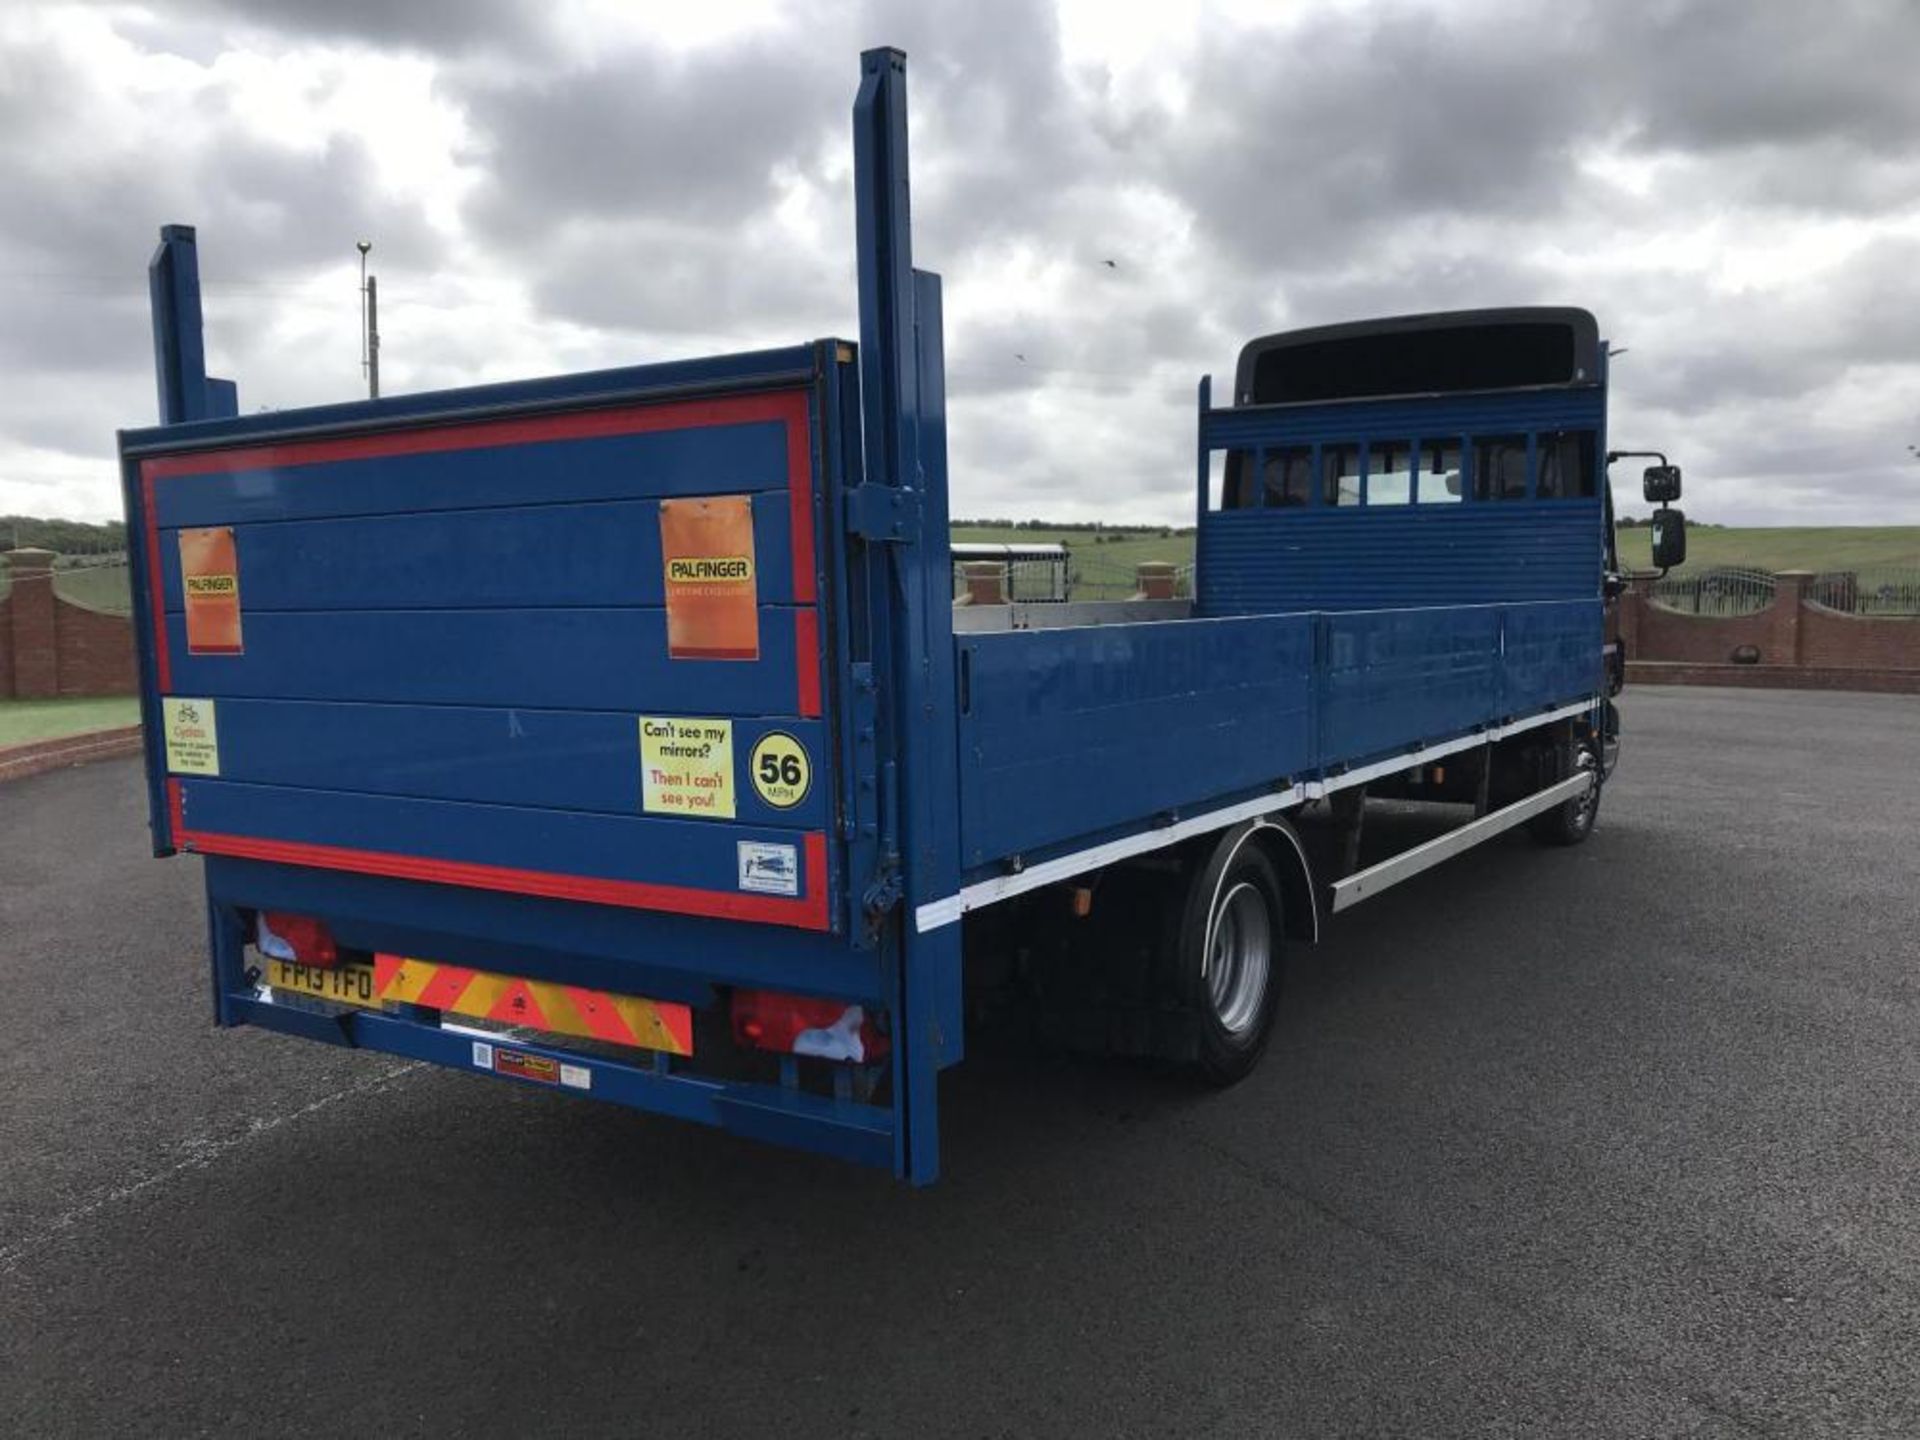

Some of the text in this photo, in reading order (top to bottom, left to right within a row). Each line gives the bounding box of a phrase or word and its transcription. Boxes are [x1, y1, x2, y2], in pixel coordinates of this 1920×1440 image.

[671, 561, 748, 579] PALFINGER
[187, 577, 233, 591] PALFINGER
[644, 721, 726, 743] Can't see my
[660, 742, 711, 758] mirrors?
[759, 753, 801, 786] 56
[651, 769, 682, 785] Then
[694, 771, 723, 788] can't
[767, 786, 795, 799] MPH
[661, 794, 716, 809] see you!
